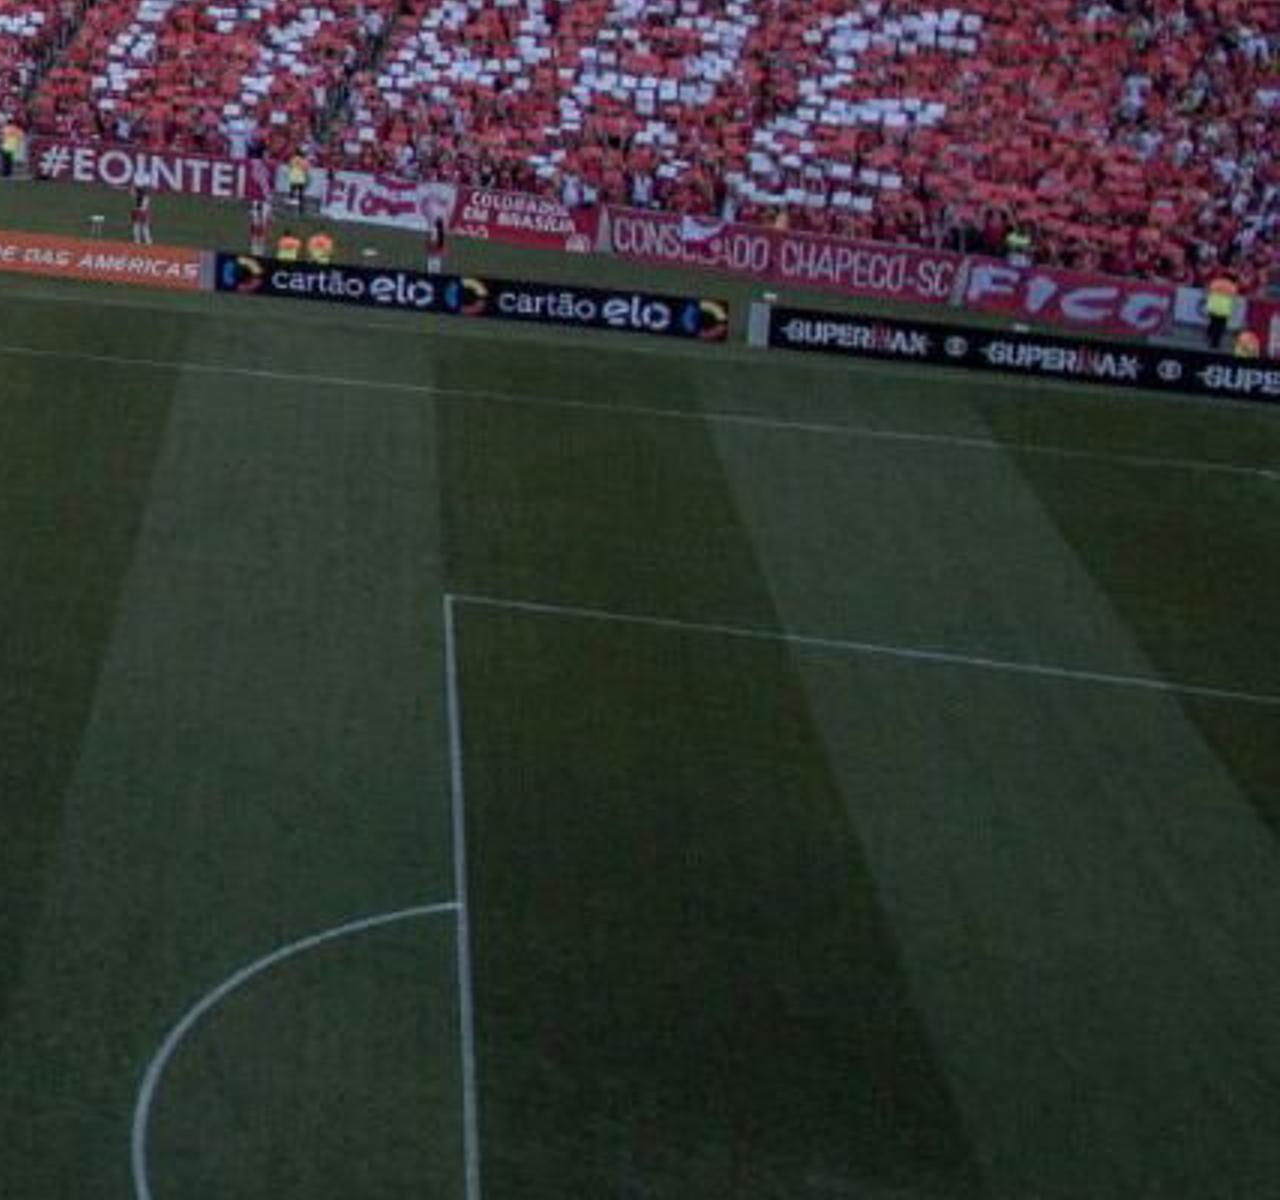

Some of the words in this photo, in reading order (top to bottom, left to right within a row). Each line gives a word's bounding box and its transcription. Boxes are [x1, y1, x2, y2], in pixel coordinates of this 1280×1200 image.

[25, 245, 72, 268] DAS
[271, 265, 365, 298] cartão
[369, 271, 435, 307] elo
[498, 288, 596, 322] cartão
[601, 293, 672, 331] elo
[781, 317, 930, 357] SUPERMAX
[981, 341, 1142, 382] SUPERMAX
